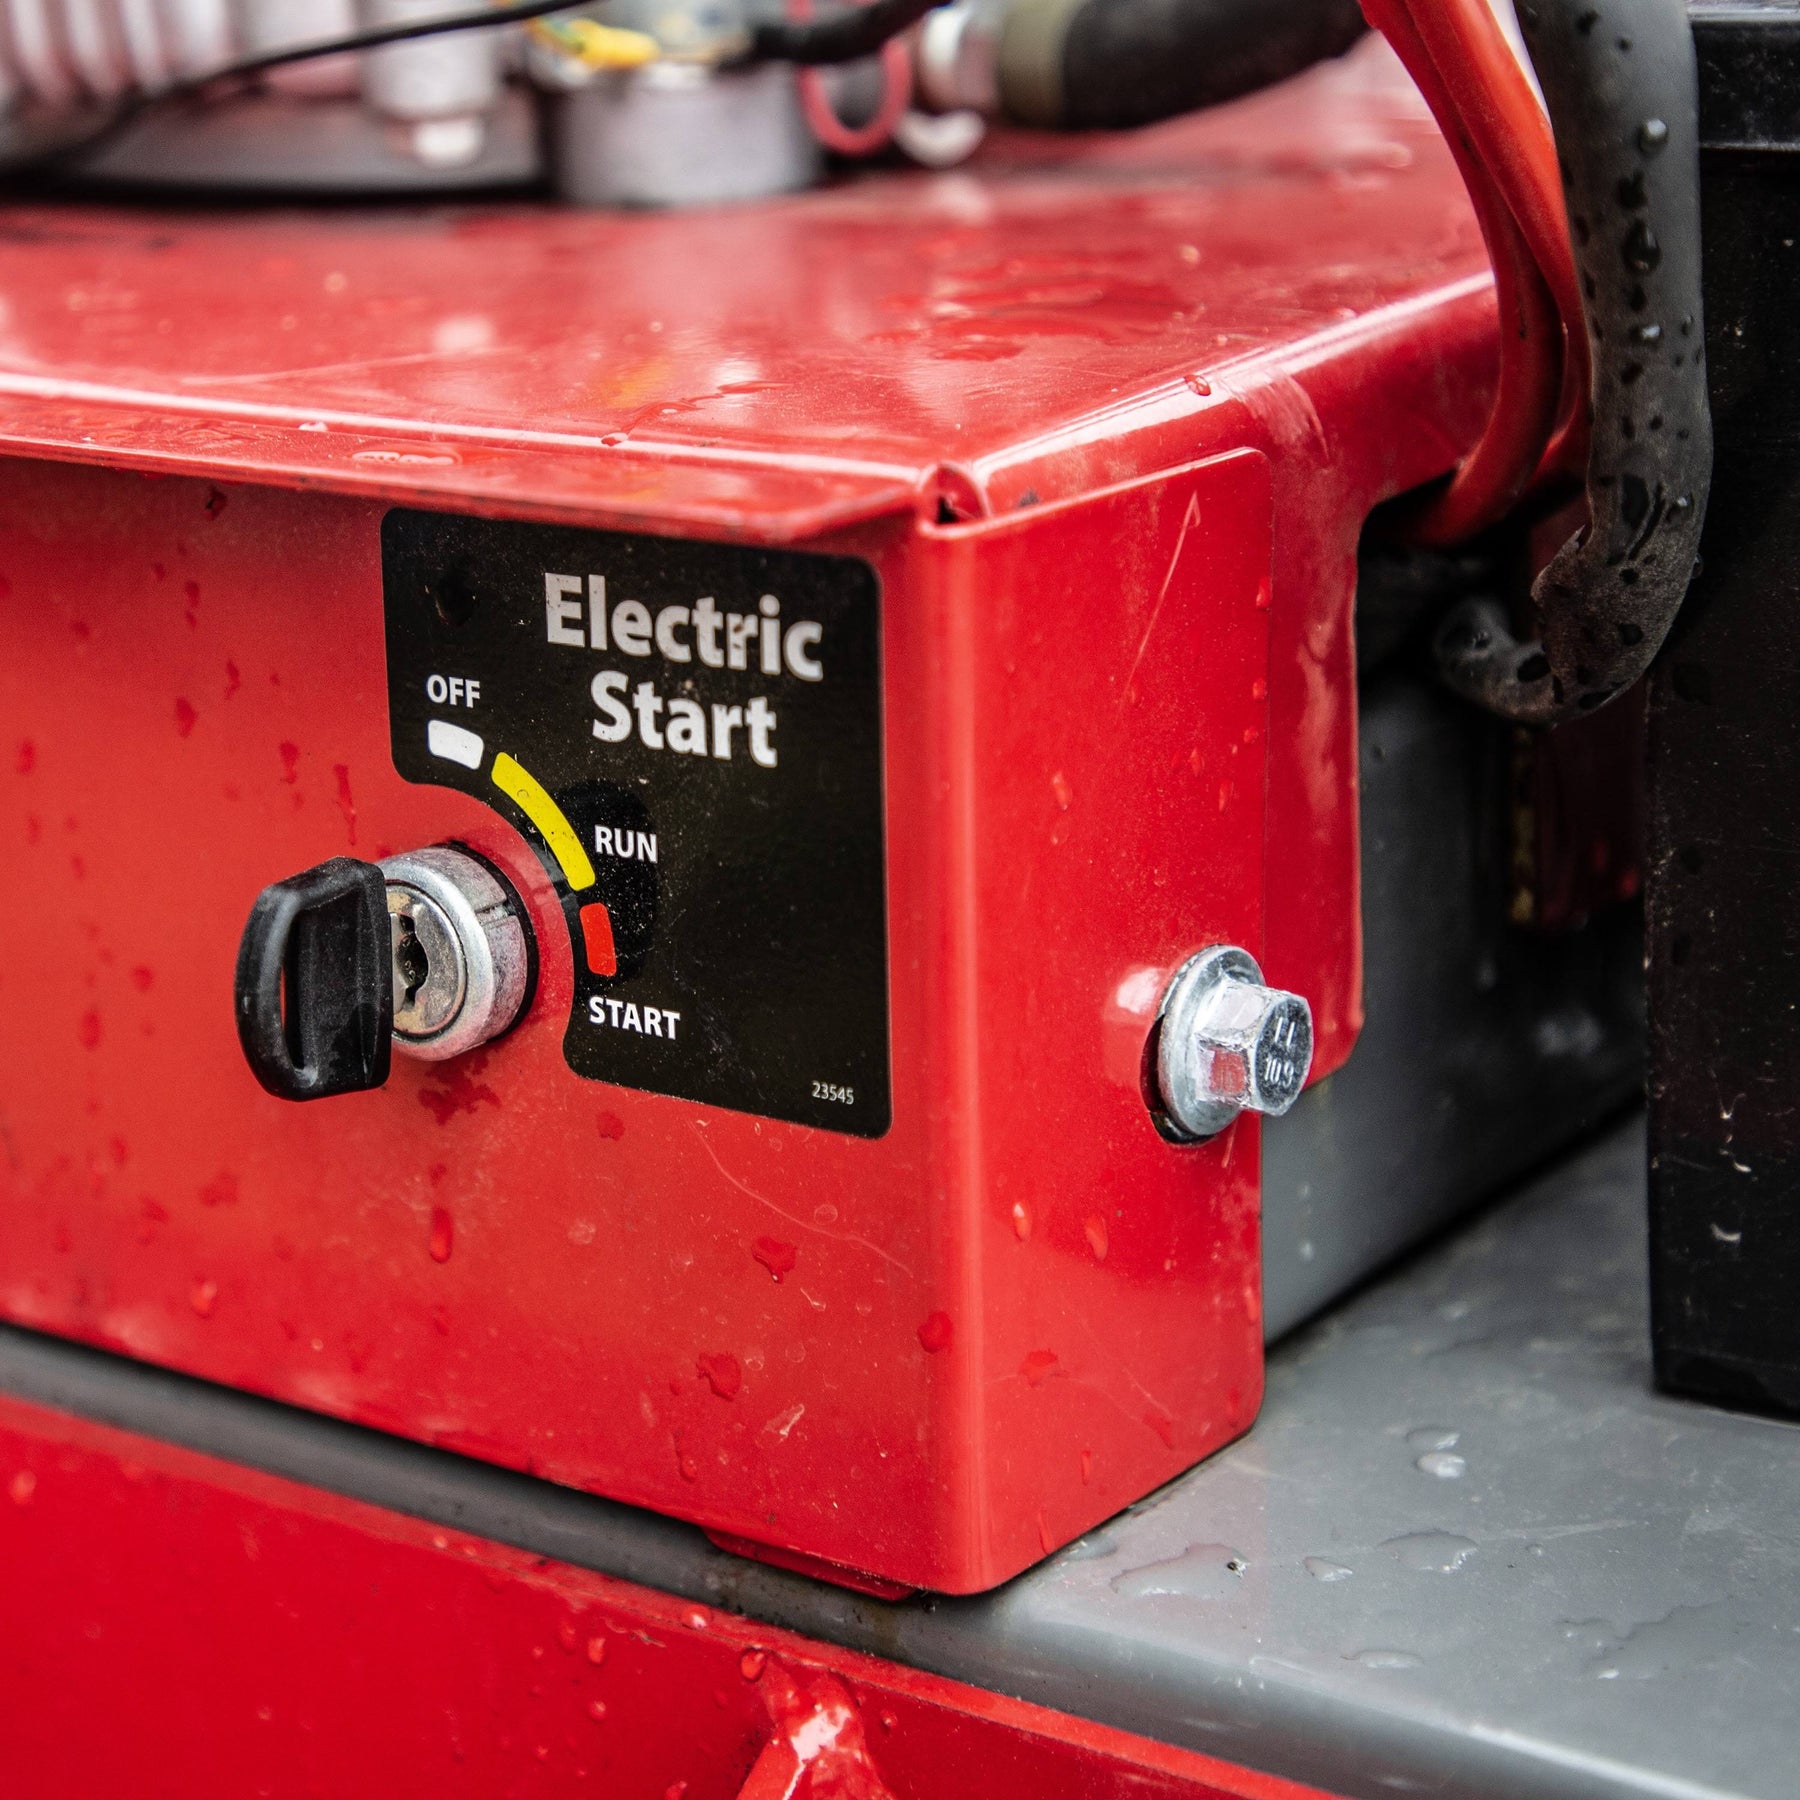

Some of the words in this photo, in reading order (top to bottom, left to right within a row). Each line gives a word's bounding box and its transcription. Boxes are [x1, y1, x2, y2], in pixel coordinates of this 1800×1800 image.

[545, 573, 823, 681] Electric
[426, 675, 481, 708] OFF
[592, 670, 778, 768] Start
[594, 825, 658, 864] RUN
[589, 996, 681, 1040] START
[812, 1082, 855, 1105] 23545
